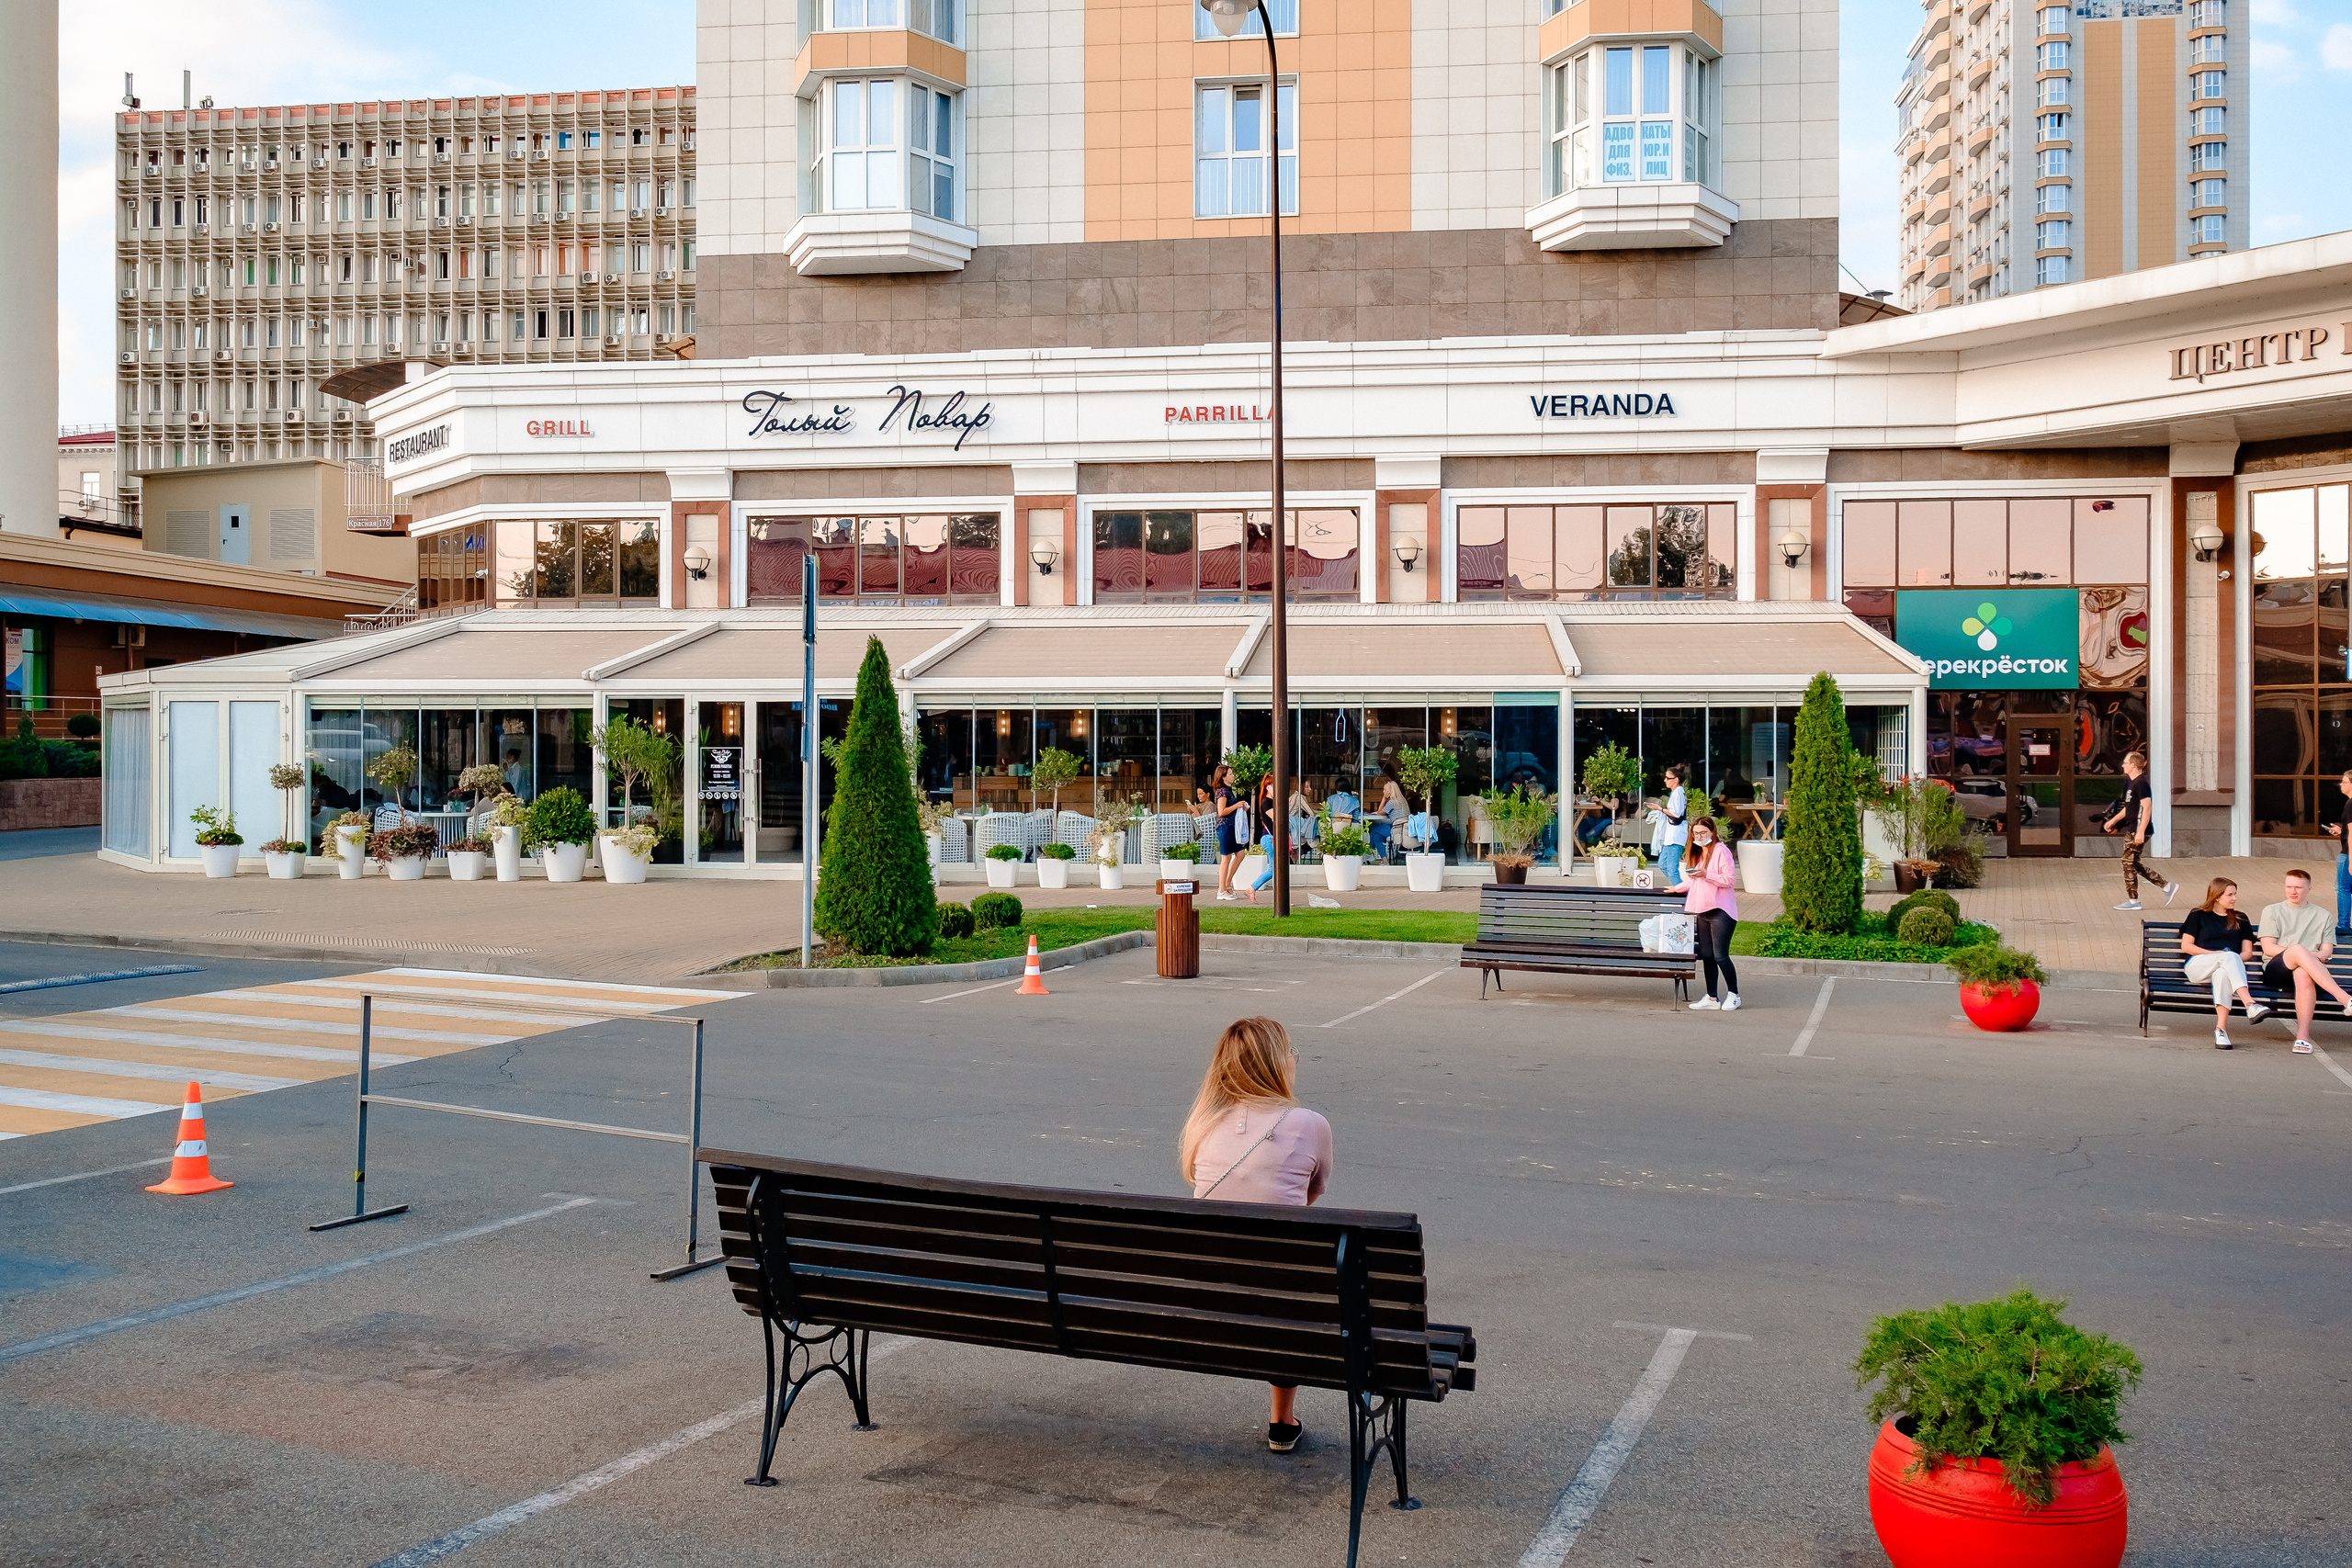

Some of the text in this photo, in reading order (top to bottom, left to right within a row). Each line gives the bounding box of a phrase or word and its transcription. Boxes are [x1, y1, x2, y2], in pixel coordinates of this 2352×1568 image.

[1608, 144, 1631, 160] ДЛЯ
[1606, 161, 1668, 176] ФИЗ. ЛИЦ
[2168, 327, 2329, 384] ЦЕНТР
[1530, 393, 1676, 417] VERANDA
[526, 420, 591, 435] GRILL
[878, 385, 991, 451] Повар
[389, 425, 447, 463] RESTAURANT
[348, 519, 390, 528] Красная 176
[1915, 655, 2069, 679] ерекрёсток
